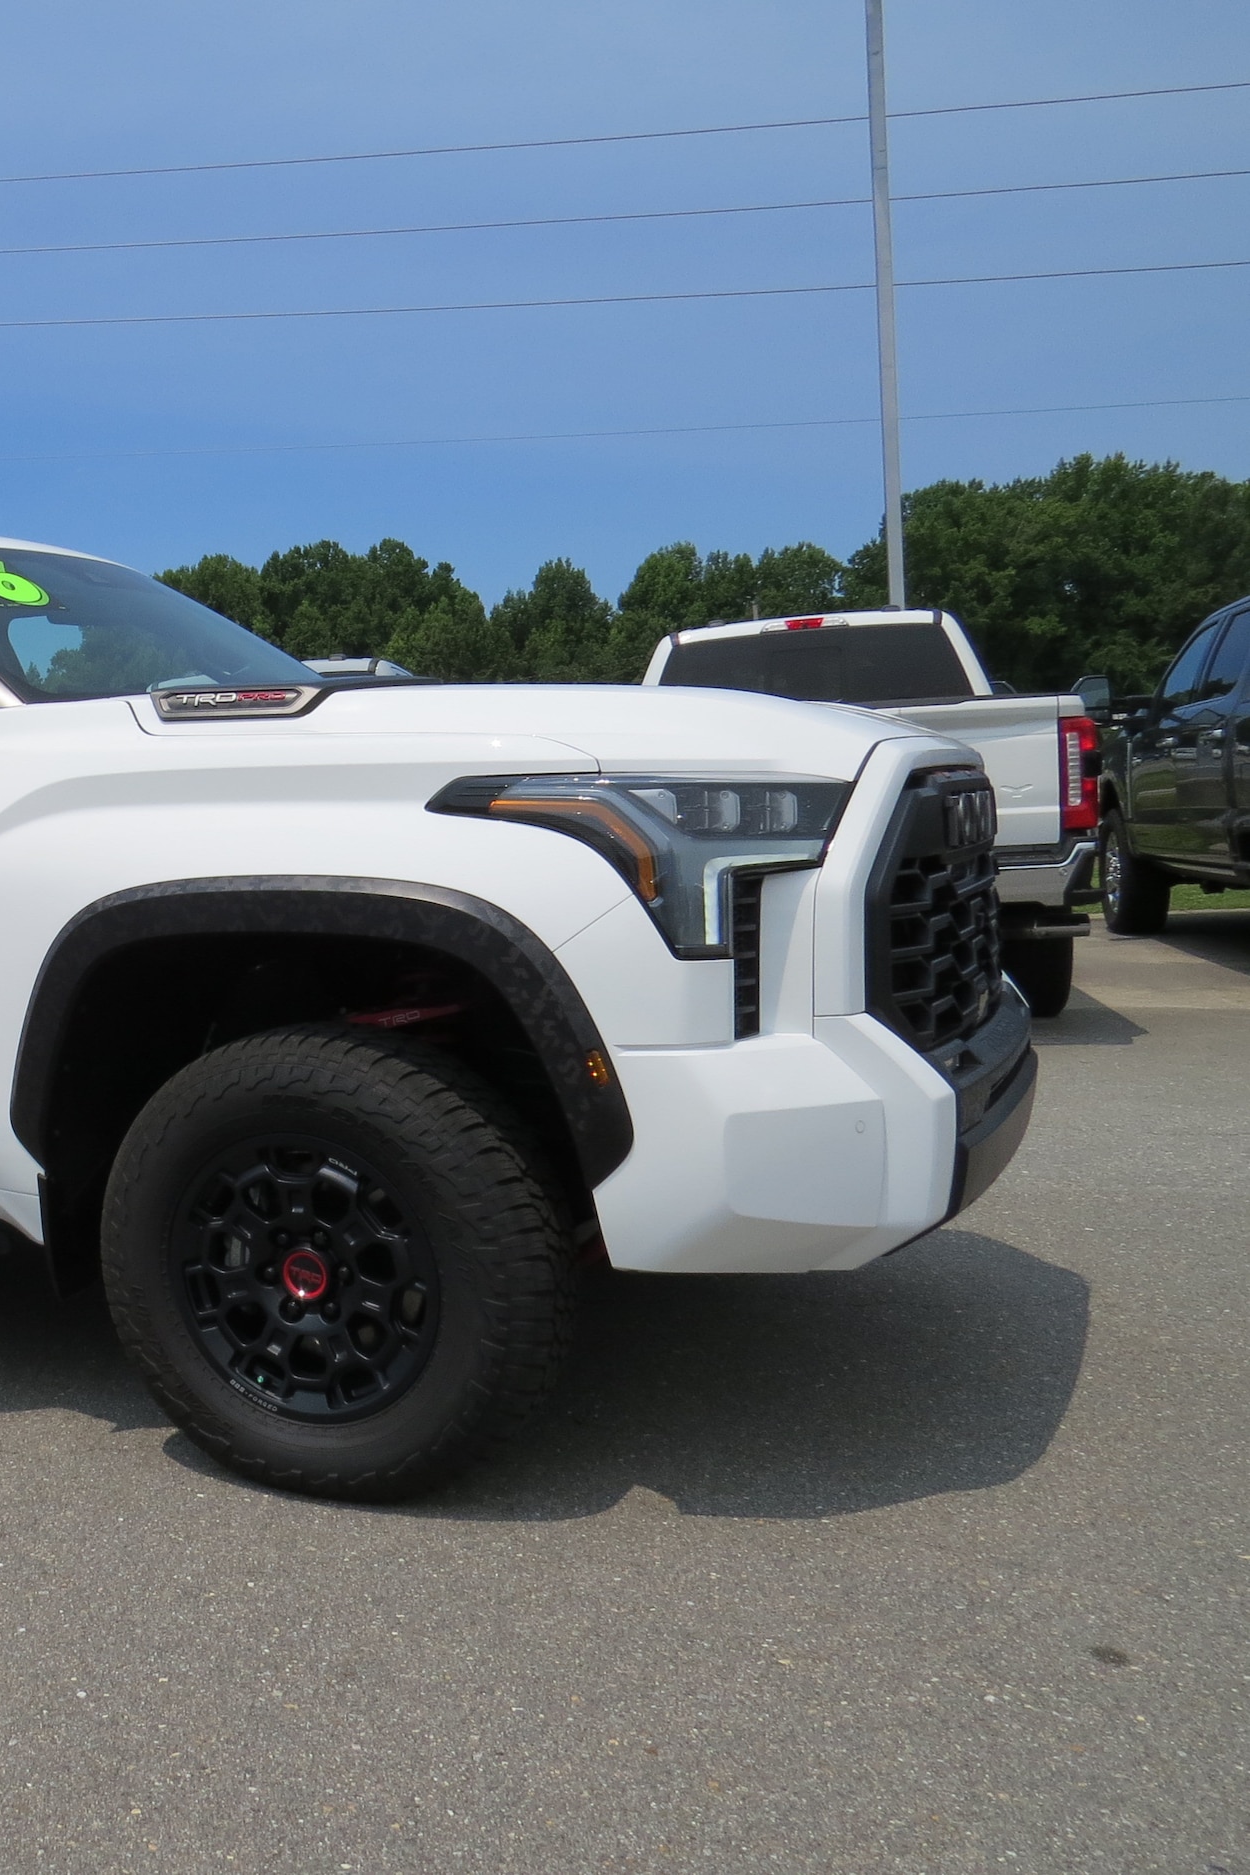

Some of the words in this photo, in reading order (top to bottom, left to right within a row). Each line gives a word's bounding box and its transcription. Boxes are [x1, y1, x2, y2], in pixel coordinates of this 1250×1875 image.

[176, 692, 237, 707] TRD
[237, 691, 286, 702] PRO
[378, 1010, 420, 1027] TRD
